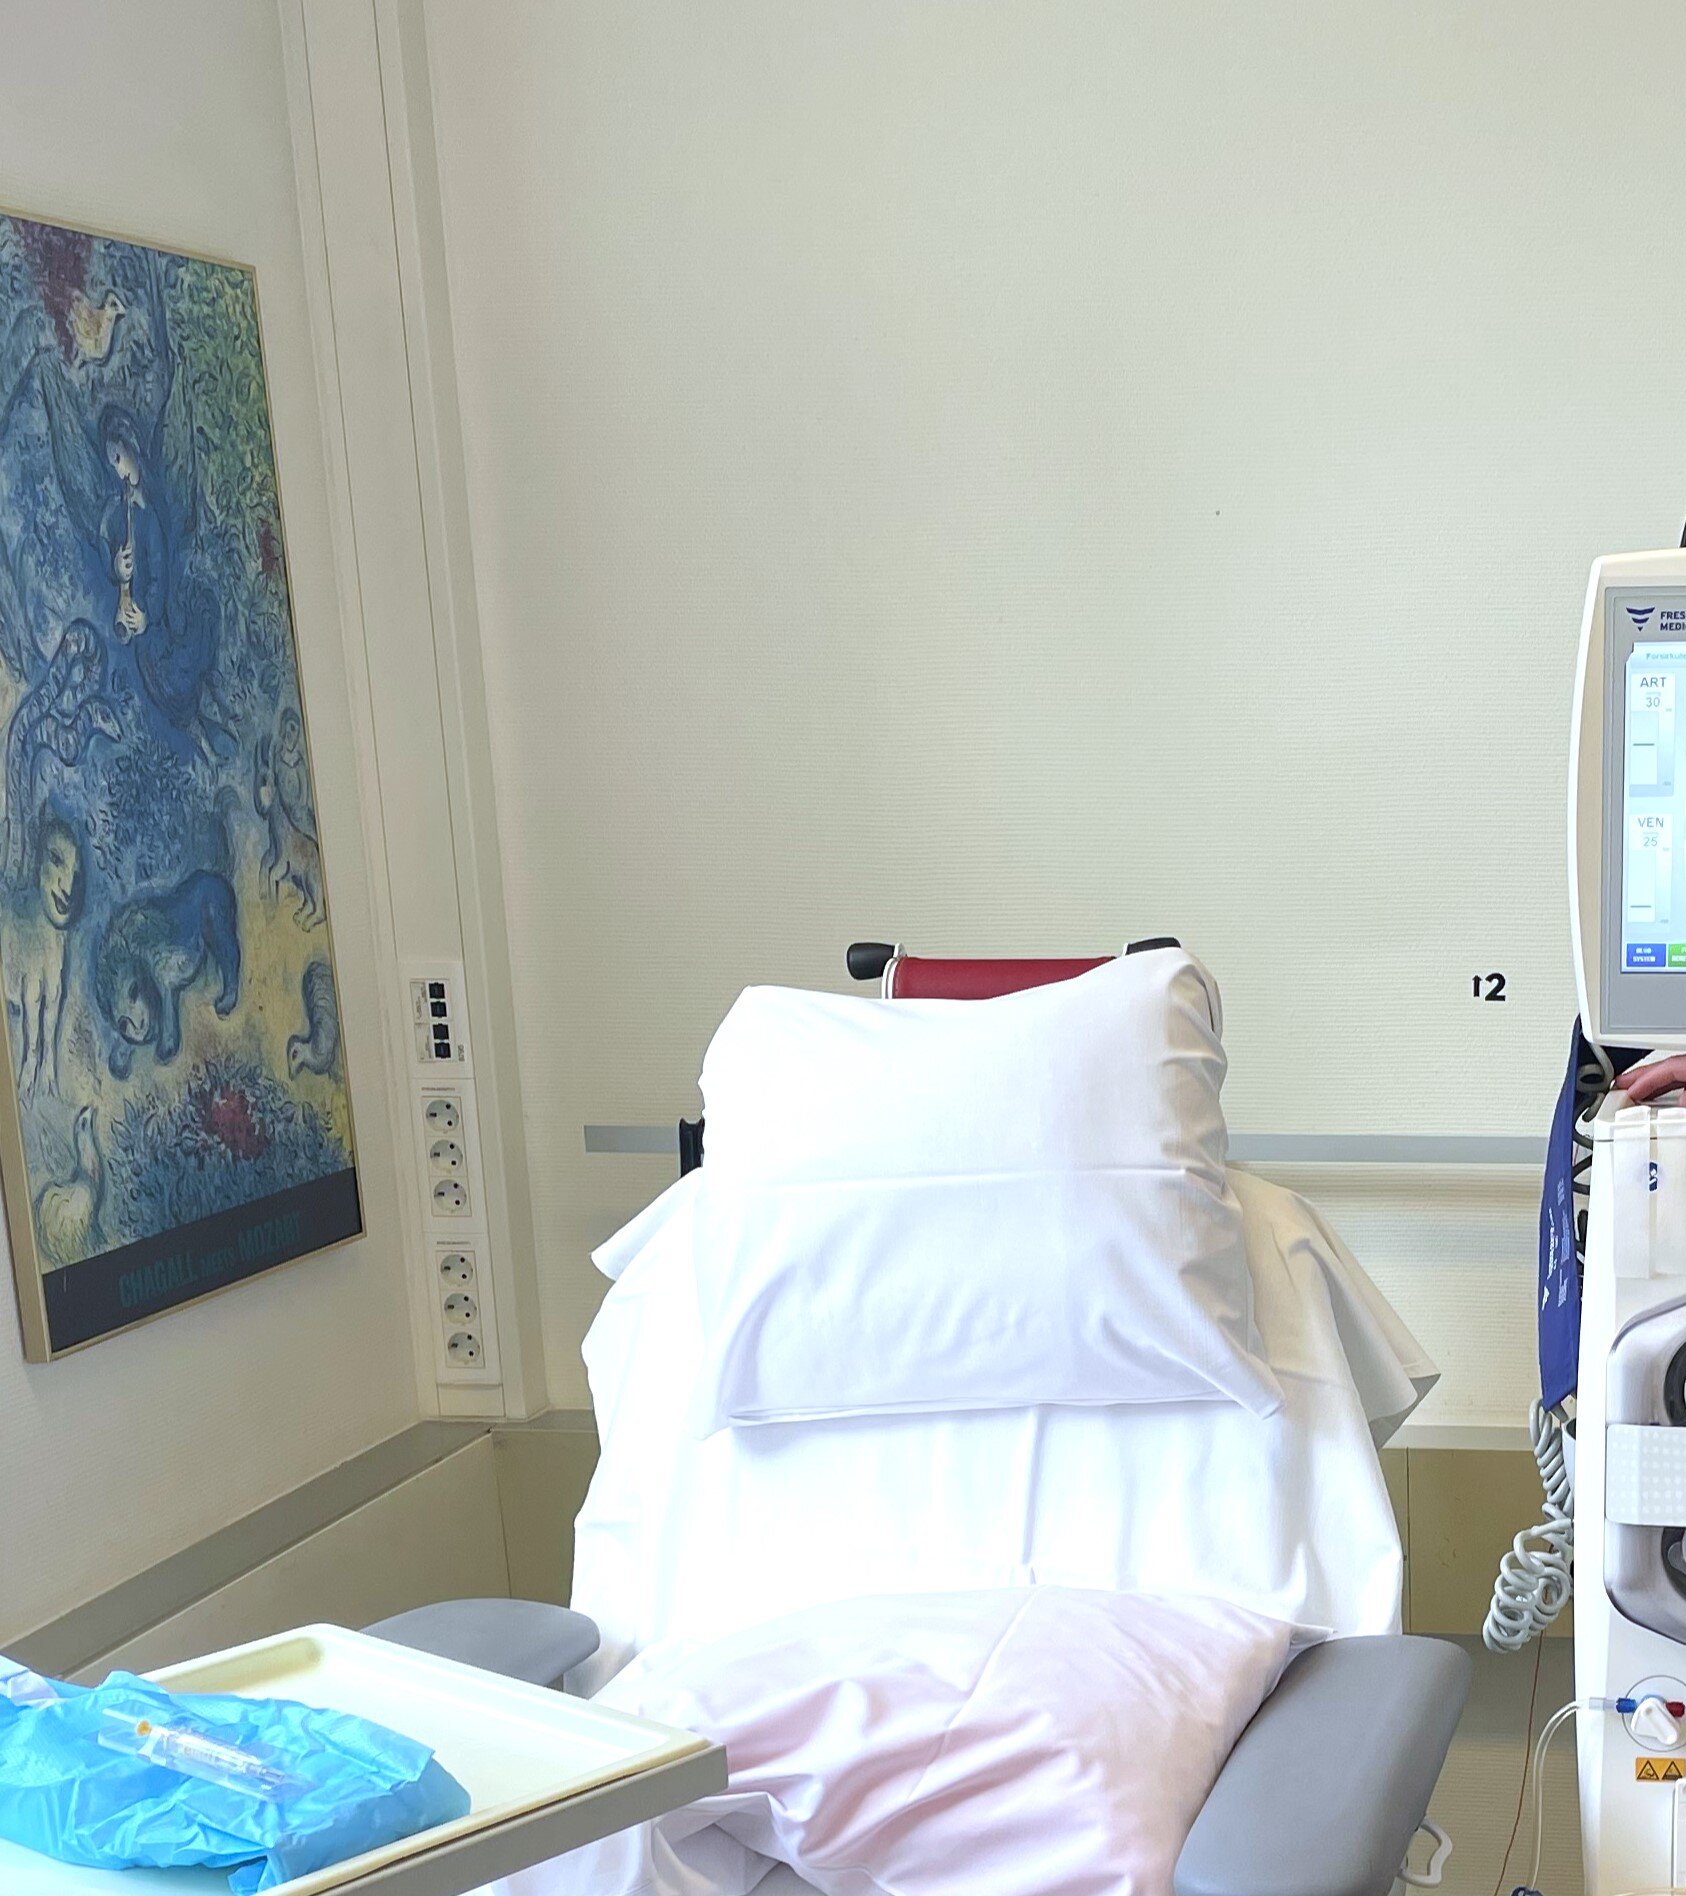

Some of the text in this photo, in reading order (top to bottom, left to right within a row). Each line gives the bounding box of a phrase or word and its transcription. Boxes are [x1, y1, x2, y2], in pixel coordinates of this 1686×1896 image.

[1640, 677, 1667, 688] ART
[1645, 697, 1661, 708] 30
[1637, 817, 1664, 828] VEN
[1643, 836, 1658, 847] 25
